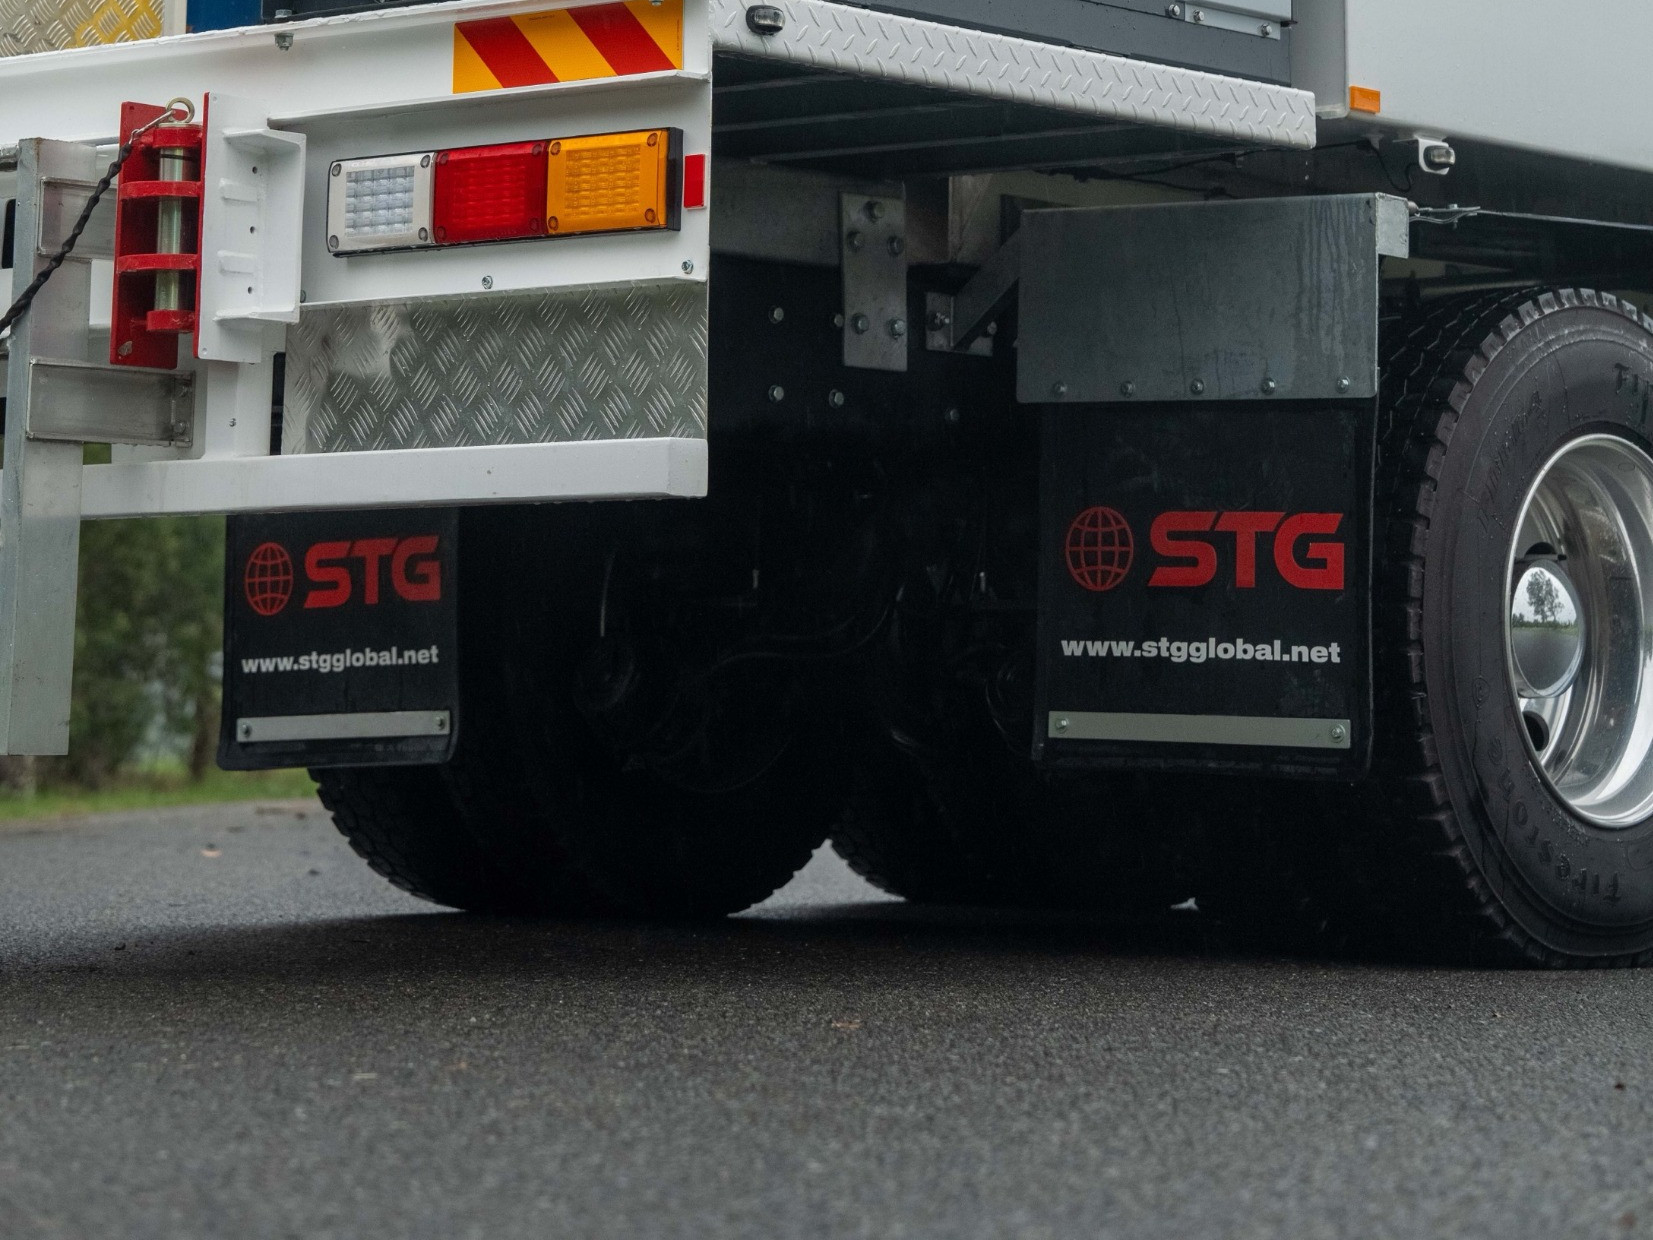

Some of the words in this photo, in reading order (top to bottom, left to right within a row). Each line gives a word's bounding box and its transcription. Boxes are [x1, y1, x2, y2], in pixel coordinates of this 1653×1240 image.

[303, 534, 442, 609] STG
[1146, 510, 1345, 590] STG
[241, 644, 439, 674] www.stgglobal.net
[1060, 636, 1341, 664] www.stgglobal.net
